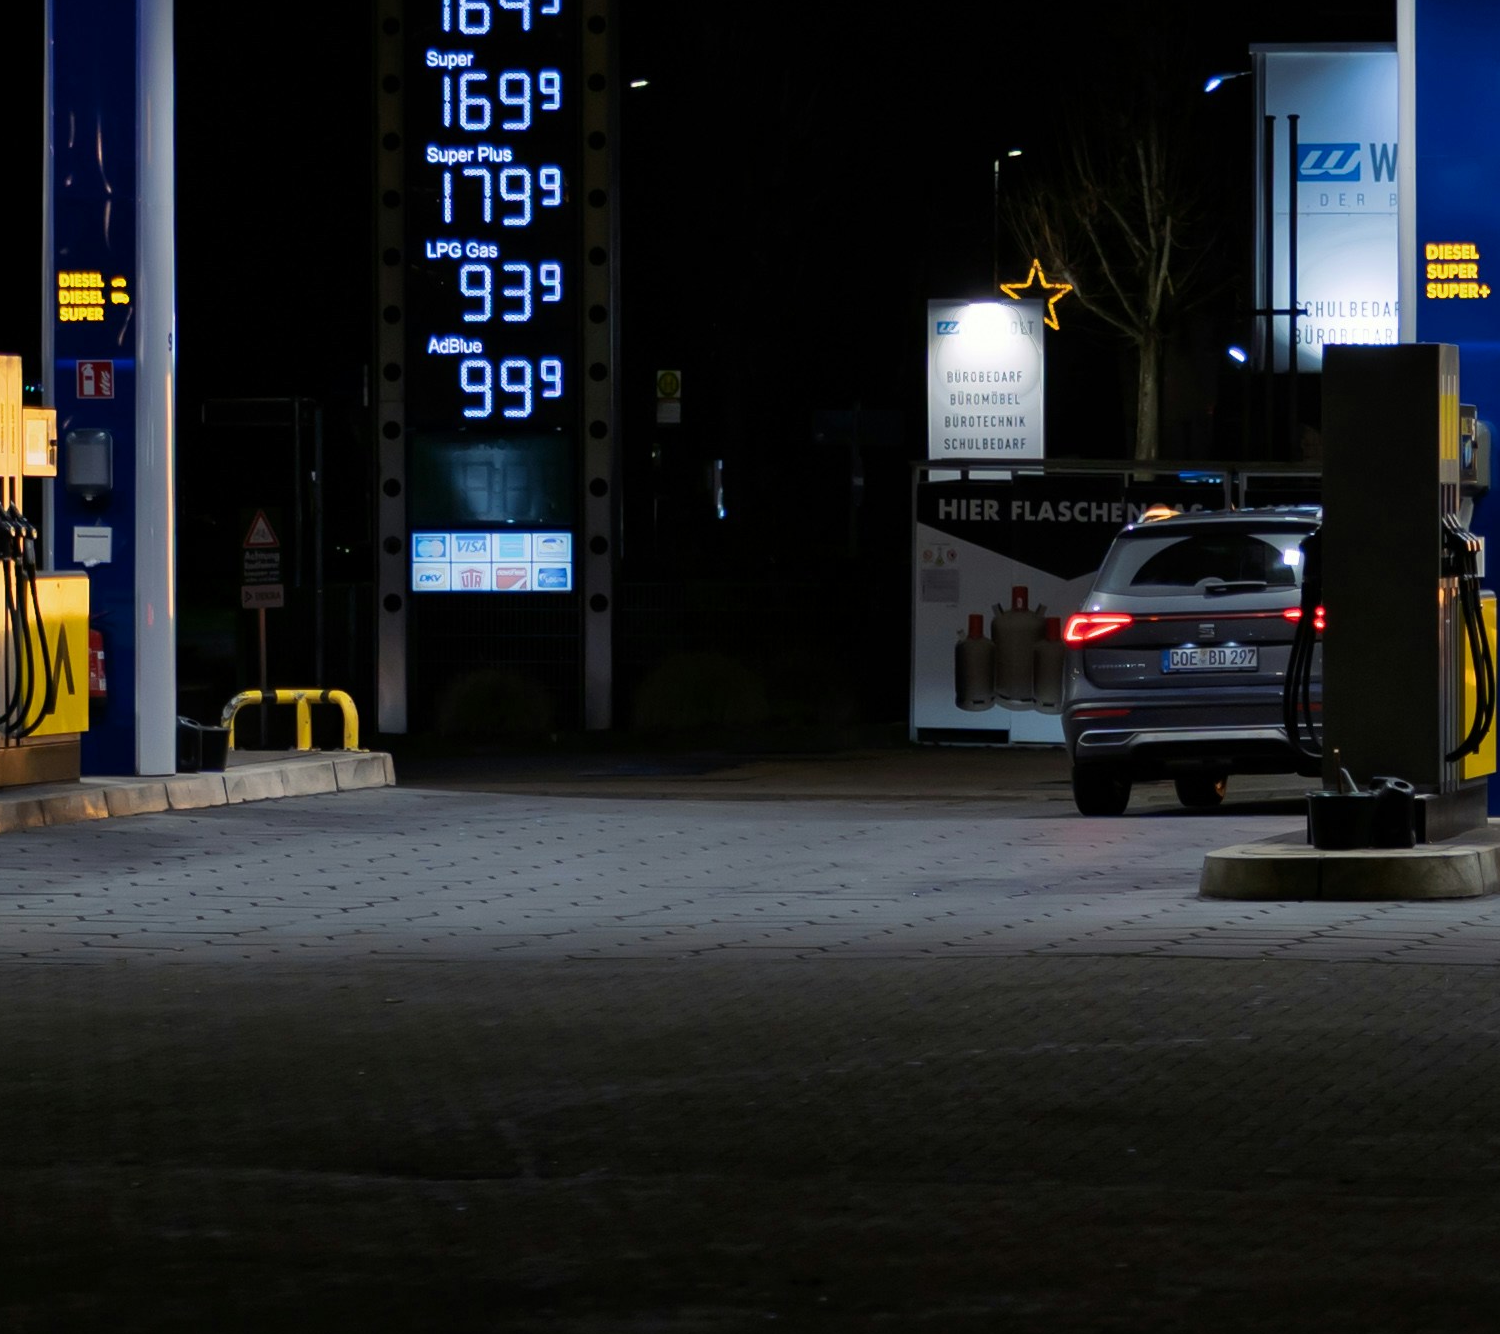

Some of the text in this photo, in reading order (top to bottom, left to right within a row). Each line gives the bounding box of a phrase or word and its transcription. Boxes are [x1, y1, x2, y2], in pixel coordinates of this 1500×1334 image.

[426, 51, 474, 69] Super
[426, 146, 513, 166] Super Plus
[1320, 193, 1366, 207] DER
[426, 242, 499, 258] LPG Gas
[1426, 244, 1479, 260] DIESEL
[1426, 263, 1478, 279] SUPER
[58, 272, 105, 288] DIESEL
[58, 289, 105, 305] DIESEL
[1426, 282, 1491, 299] SUPER+
[59, 307, 105, 322] SUPER
[427, 337, 483, 354] AdBlue
[946, 370, 1023, 384] BÜROBEDARF
[949, 391, 1021, 406] BÜROMÖBEL
[944, 414, 1026, 428] BÜROTECHNIK
[943, 438, 1027, 451] SCHULBEDARF
[937, 498, 1002, 522] HIER
[457, 541, 487, 553] VISA
[419, 574, 442, 582] DKV
[1171, 649, 1256, 667] COE BD 297
